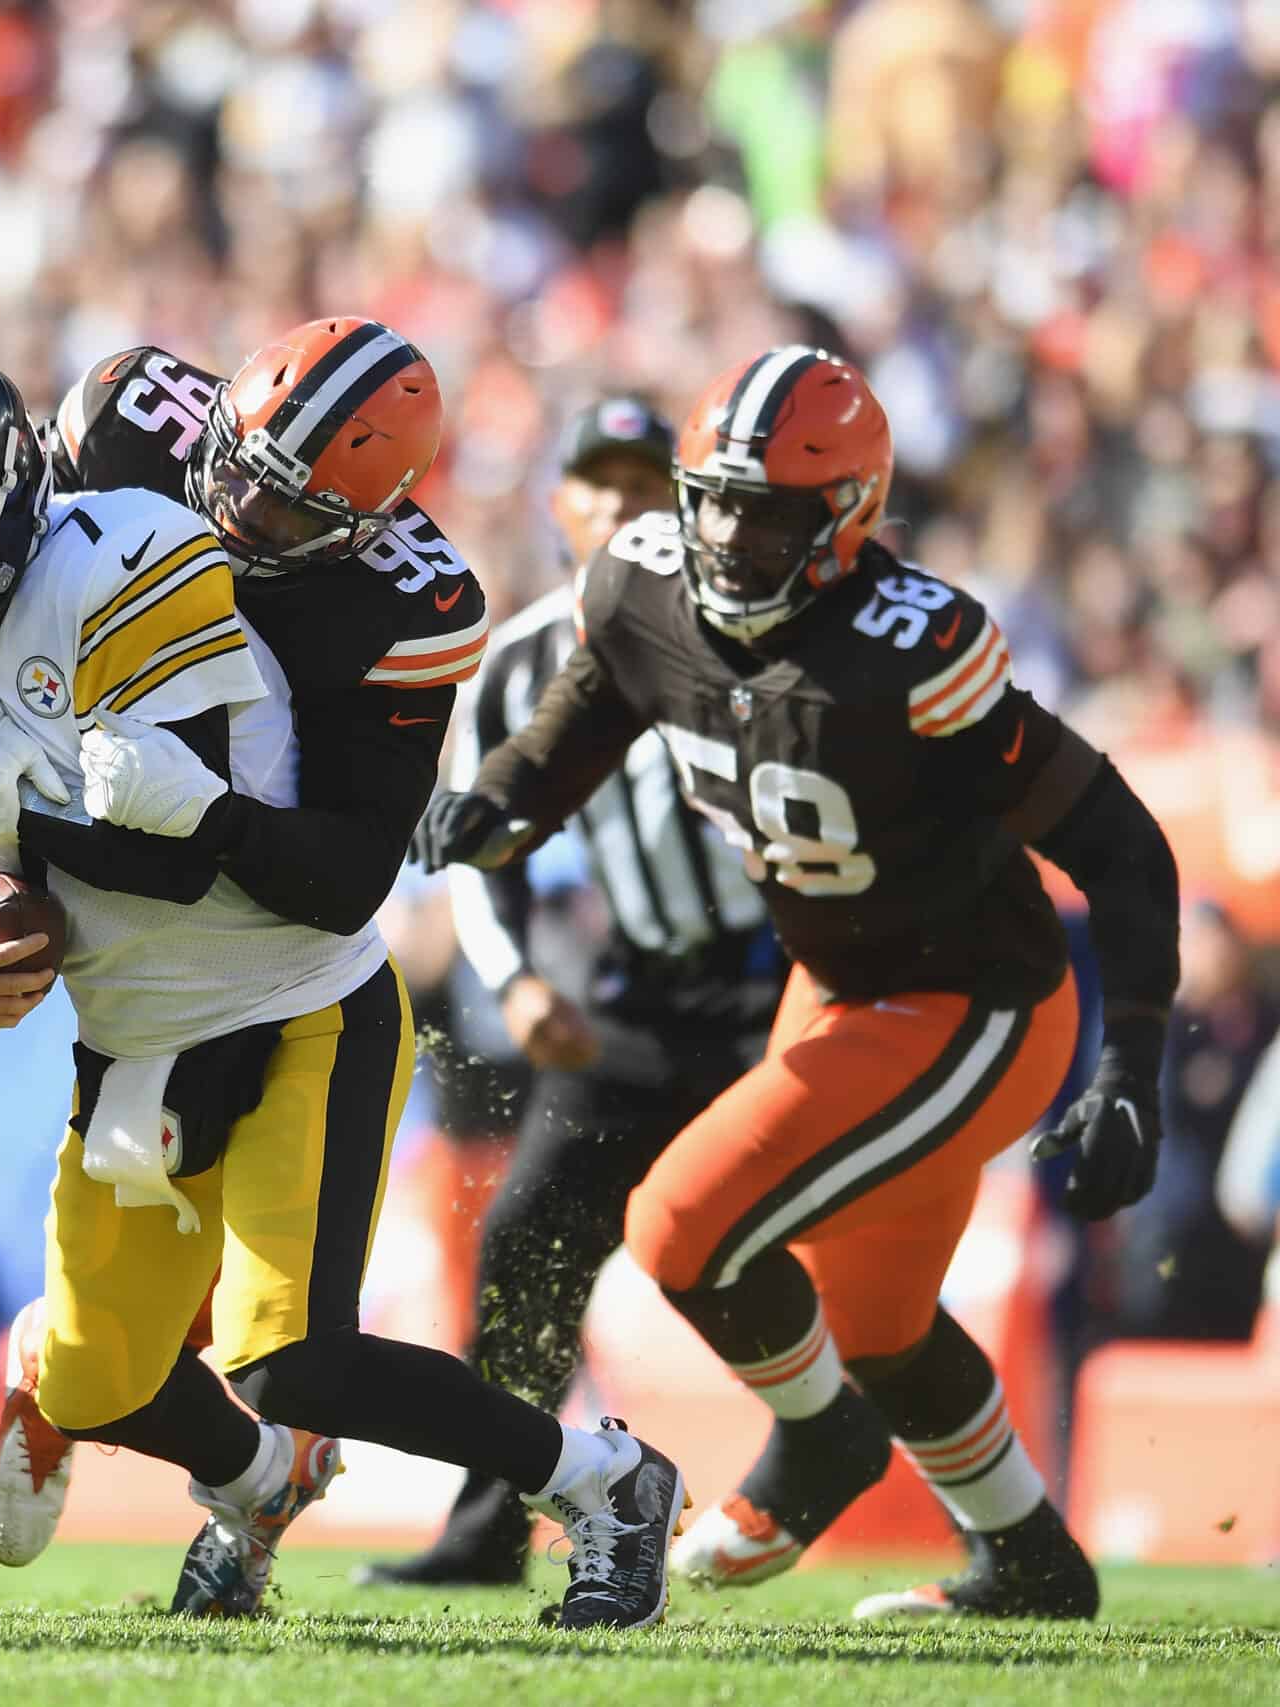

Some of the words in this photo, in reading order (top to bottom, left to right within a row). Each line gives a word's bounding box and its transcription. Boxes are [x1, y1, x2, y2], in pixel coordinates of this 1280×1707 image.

[358, 512, 468, 593] 95
[852, 575, 955, 650] 58
[656, 721, 876, 896] 58
